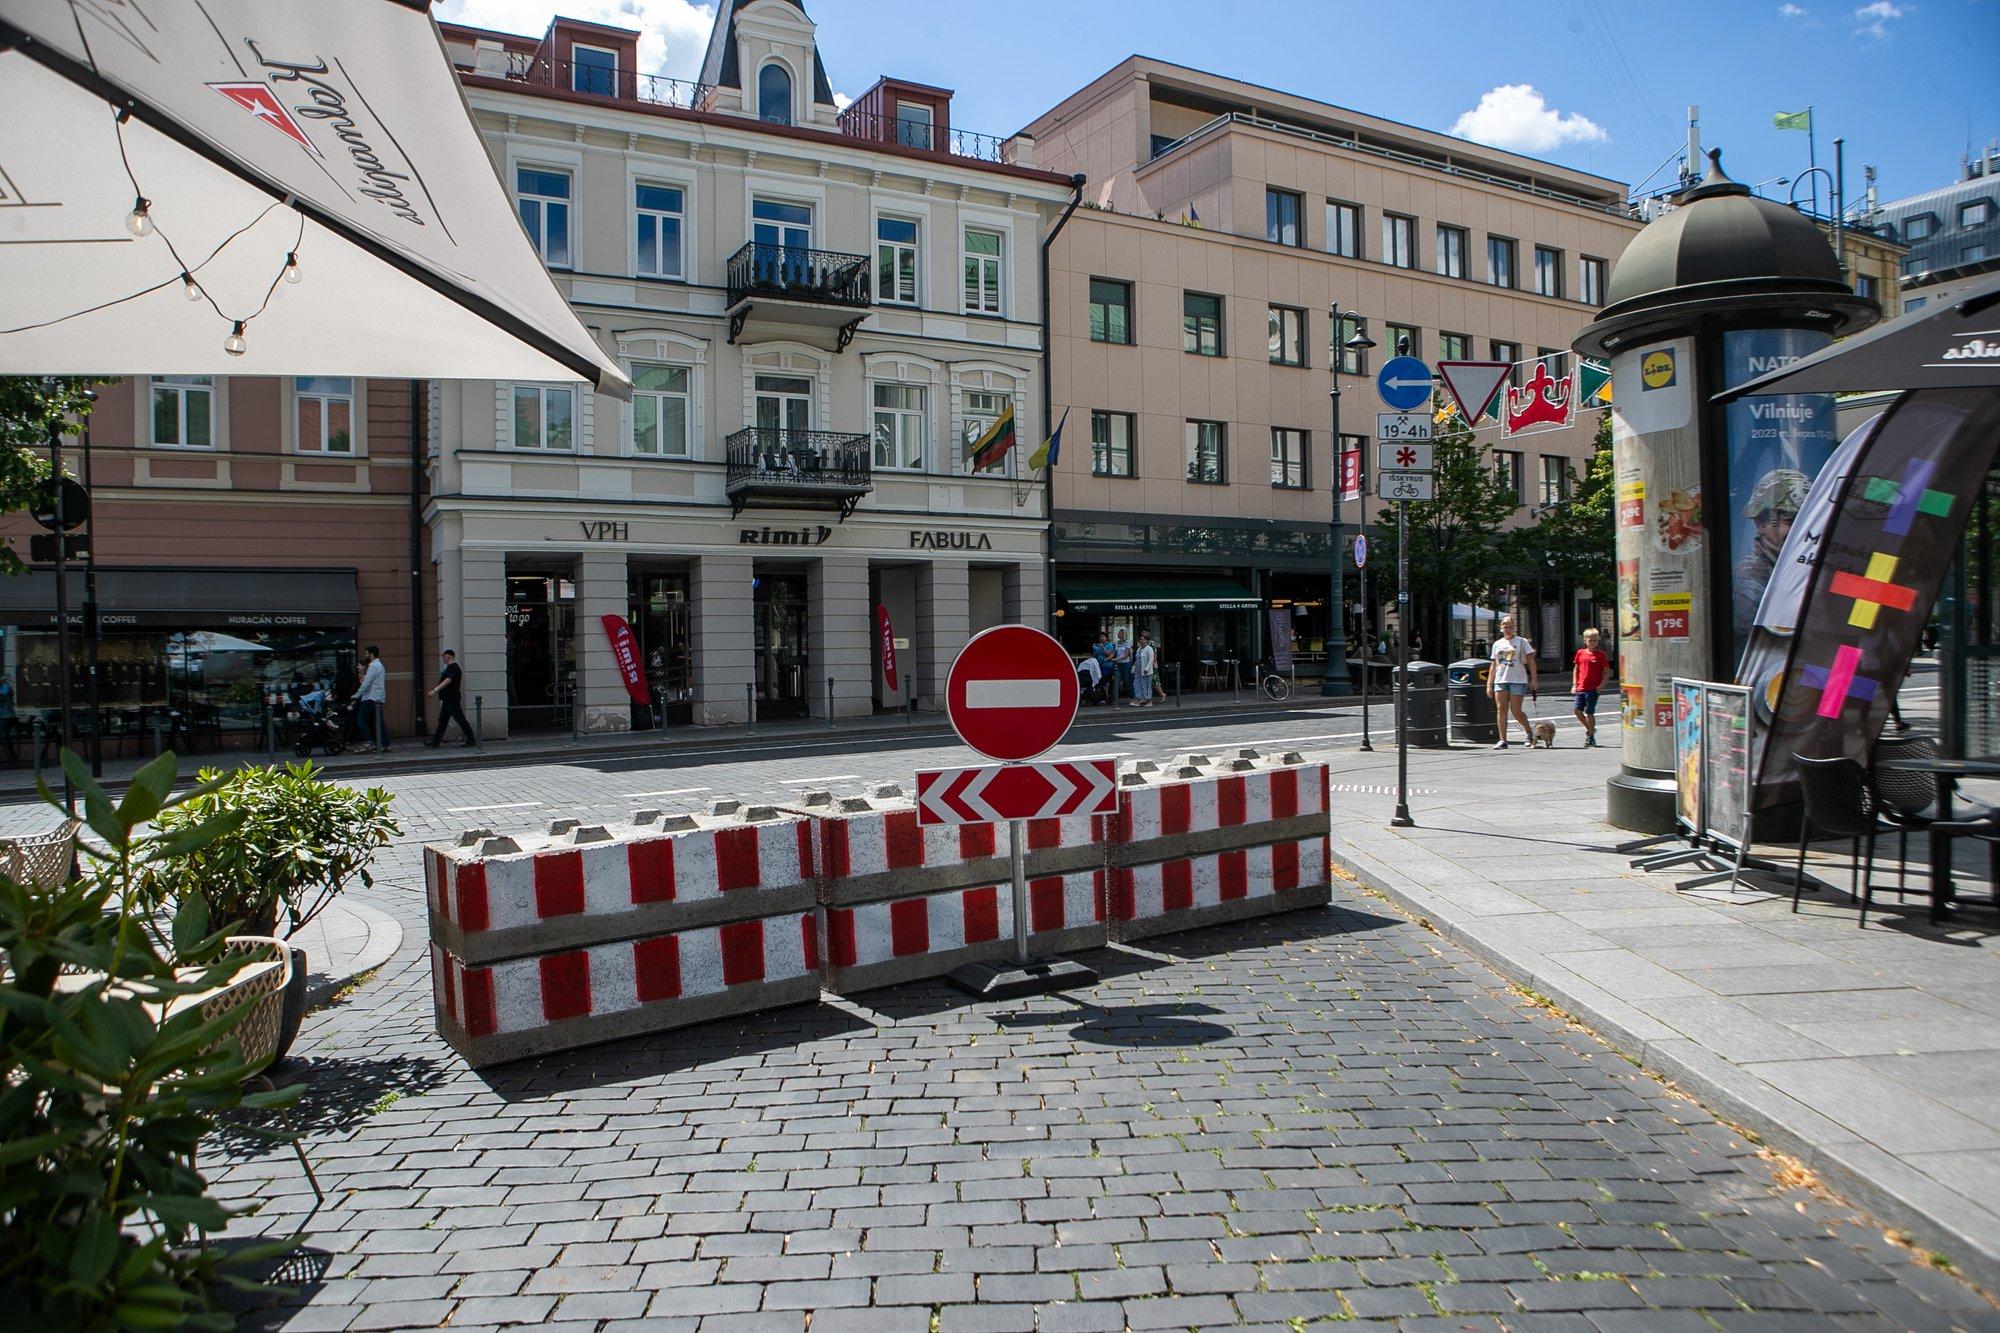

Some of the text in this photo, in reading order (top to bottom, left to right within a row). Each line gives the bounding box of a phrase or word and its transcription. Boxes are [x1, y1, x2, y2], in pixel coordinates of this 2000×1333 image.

[1749, 402, 1814, 423] Vilniuje
[1752, 428, 1777, 439] 2023
[580, 521, 629, 541] VPH
[740, 526, 811, 545] Rimi
[910, 530, 993, 550] FABULA
[102, 616, 137, 624] COFFEE
[275, 616, 307, 624] COFFEE
[510, 613, 530, 627] to go
